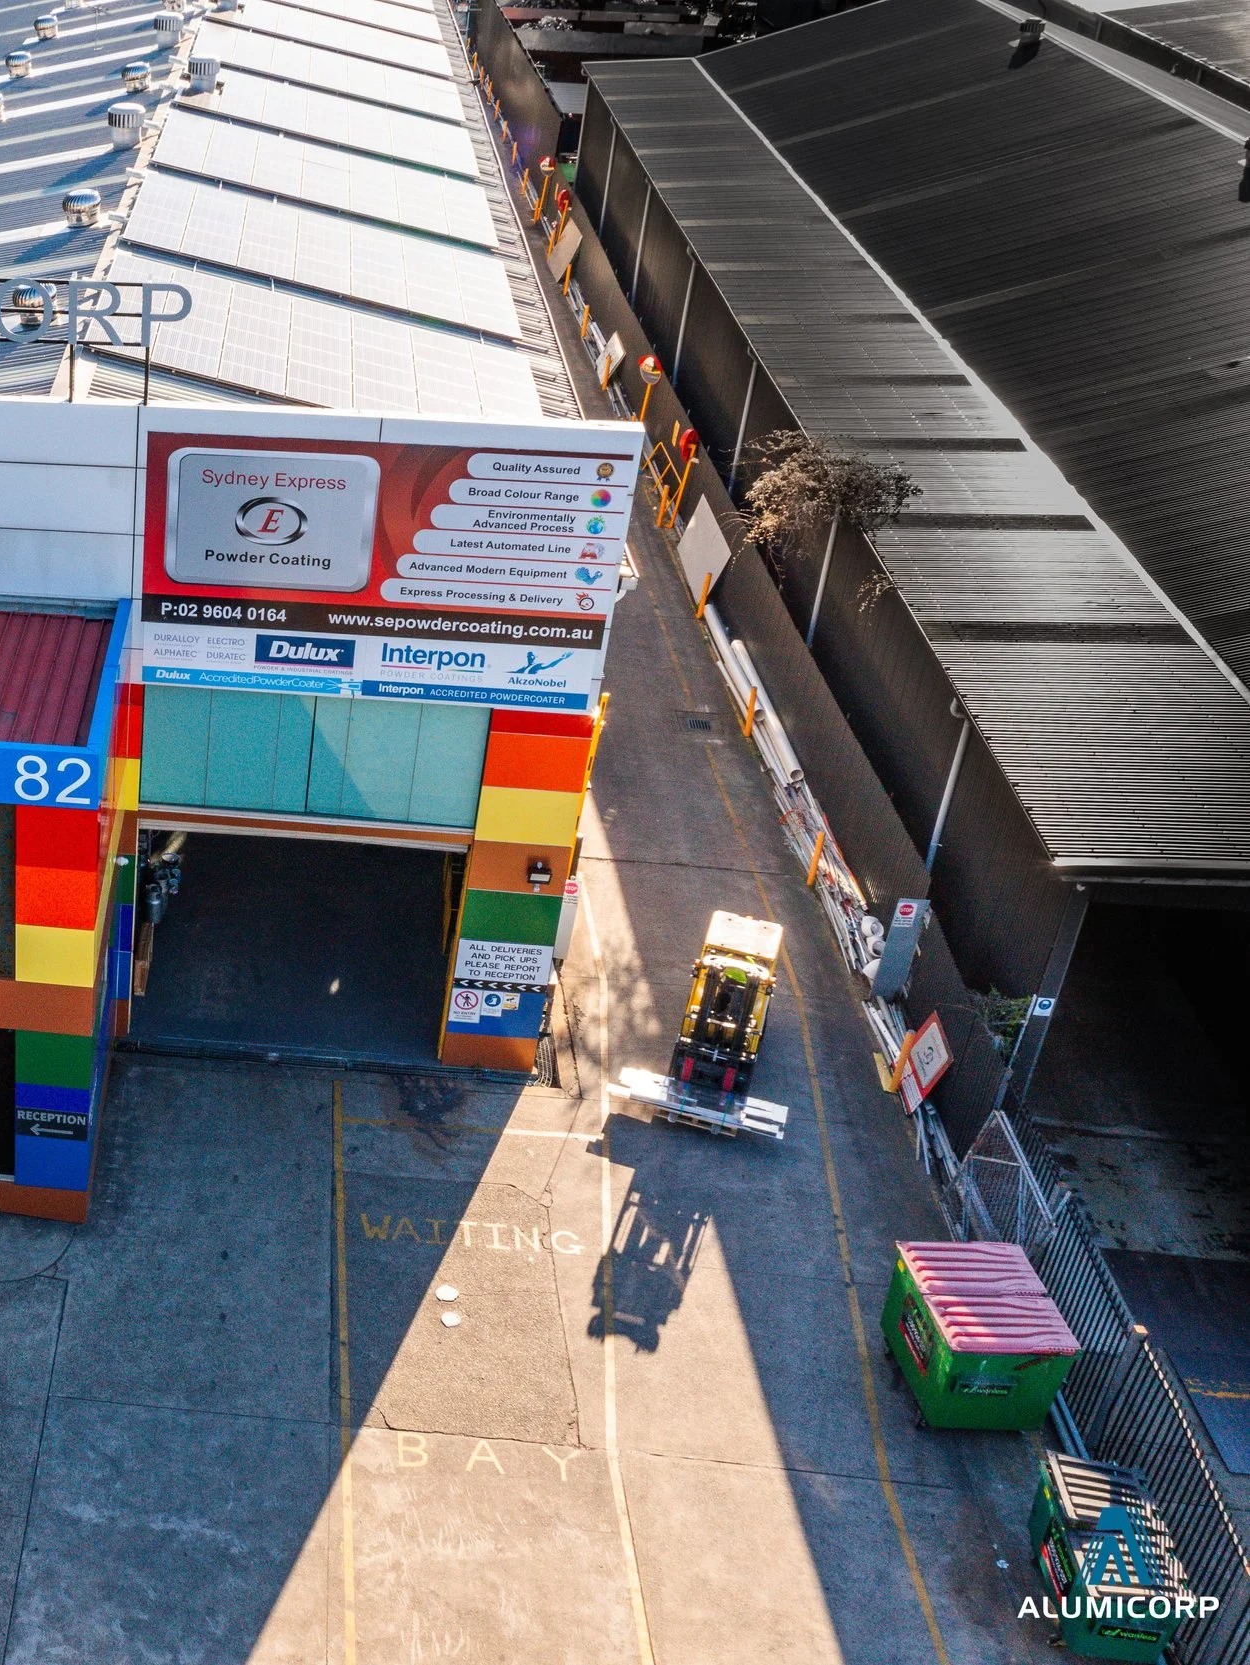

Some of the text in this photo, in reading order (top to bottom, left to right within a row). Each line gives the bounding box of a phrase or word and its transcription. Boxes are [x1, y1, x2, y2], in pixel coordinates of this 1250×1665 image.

[492, 462, 581, 475] Quality Assured
[202, 469, 347, 491] Sydney Express
[468, 487, 579, 502] Broad Colour Range
[257, 508, 284, 533] E
[488, 509, 576, 524] Environmentally
[473, 520, 574, 533] Advanced Process
[450, 538, 571, 554] Latest Automated Line
[205, 549, 331, 570] Powder Coating
[409, 561, 568, 580] Advanced Modern Equipment
[400, 587, 563, 605] Express Processing & Delivery
[161, 602, 287, 622] P:02 9604 0164
[328, 612, 593, 640] www.sepowdercoating.com.au
[154, 633, 246, 646] DURALLOY ELECTRO
[153, 648, 246, 661] ALPHATEC DURATEC
[269, 640, 339, 662] Dulux
[381, 642, 486, 670] Interpon
[155, 669, 191, 680] Dulux
[287, 666, 321, 674] INDUSTRIAL
[380, 670, 483, 683] POWDER COATINGS
[508, 676, 566, 688] AkzoNobel
[378, 683, 566, 705] Interpon ACCREDITED POWDERCOATER
[14, 754, 91, 806] 82
[469, 943, 542, 955] ALL DELIVERIES
[471, 952, 490, 960] AND
[465, 960, 541, 973] PLEASE REPORT
[484, 970, 536, 981] RECEPTION
[17, 1110, 87, 1126] RECEPTION
[360, 1212, 585, 1256] WAITING
[396, 1430, 581, 1482] BAY
